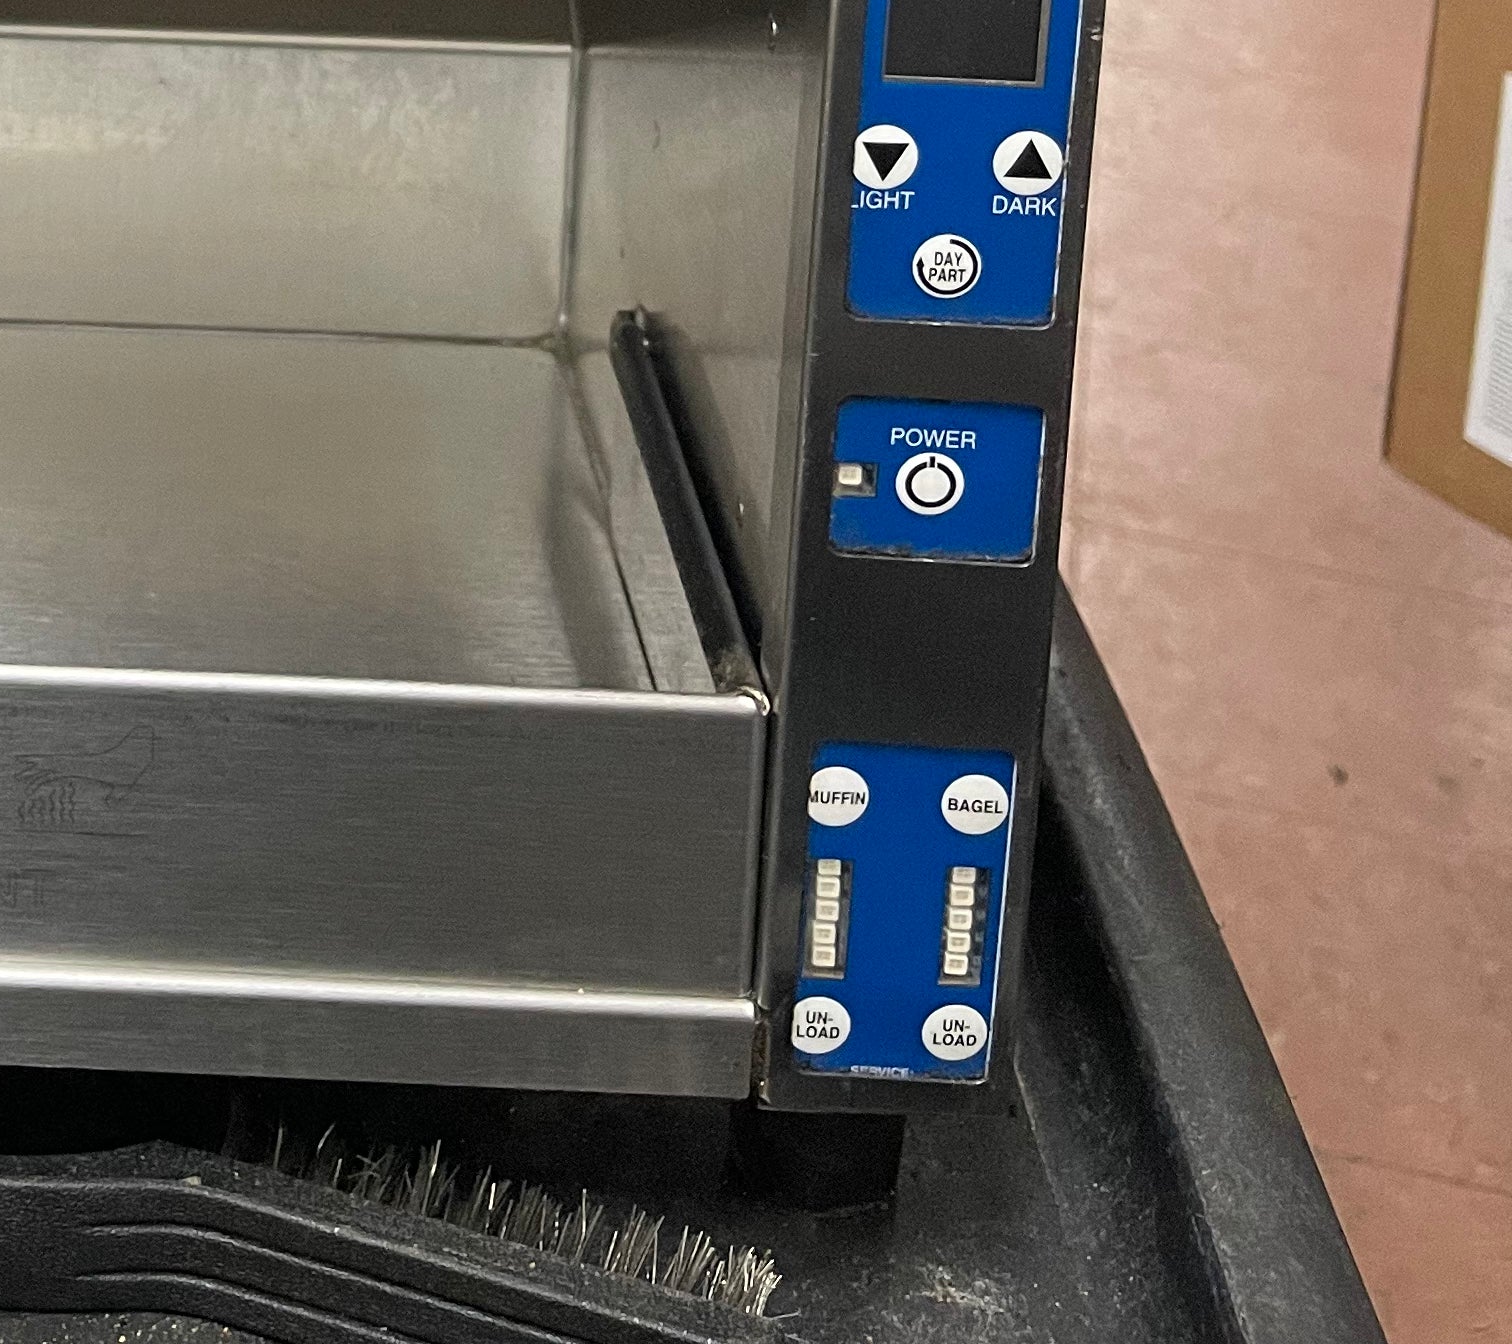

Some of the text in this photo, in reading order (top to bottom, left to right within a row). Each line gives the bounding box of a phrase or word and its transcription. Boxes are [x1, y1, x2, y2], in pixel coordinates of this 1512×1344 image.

[992, 194, 1058, 217] DARK
[934, 251, 964, 267] DAY
[928, 268, 967, 283] PART
[890, 427, 976, 450] POWER
[809, 790, 866, 805] MUFFIN
[947, 797, 1004, 814] BAGEL
[805, 1010, 834, 1025] UN-
[796, 1025, 840, 1039] LOAD
[942, 1019, 971, 1033] UN-
[932, 1033, 977, 1047] LOAD
